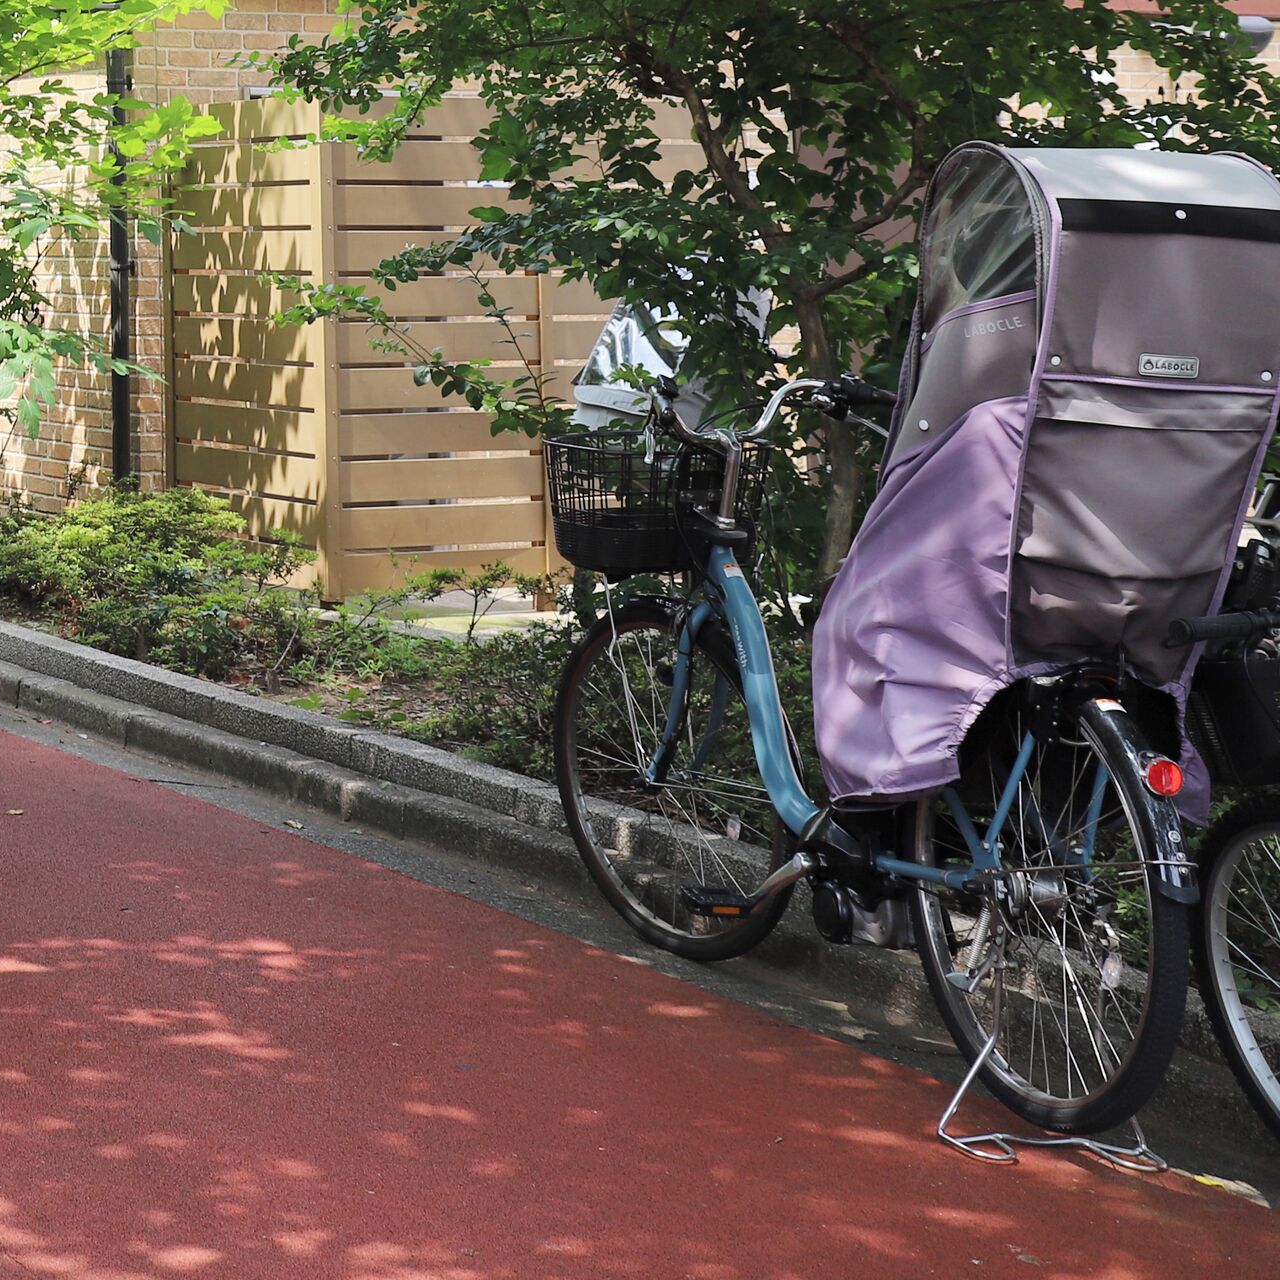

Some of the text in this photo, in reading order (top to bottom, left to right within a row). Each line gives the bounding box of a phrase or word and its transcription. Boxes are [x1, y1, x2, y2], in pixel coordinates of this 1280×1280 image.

[963, 316, 1024, 338] LABOCLE
[1155, 362, 1195, 372] LABOCLE
[737, 641, 748, 668] with
